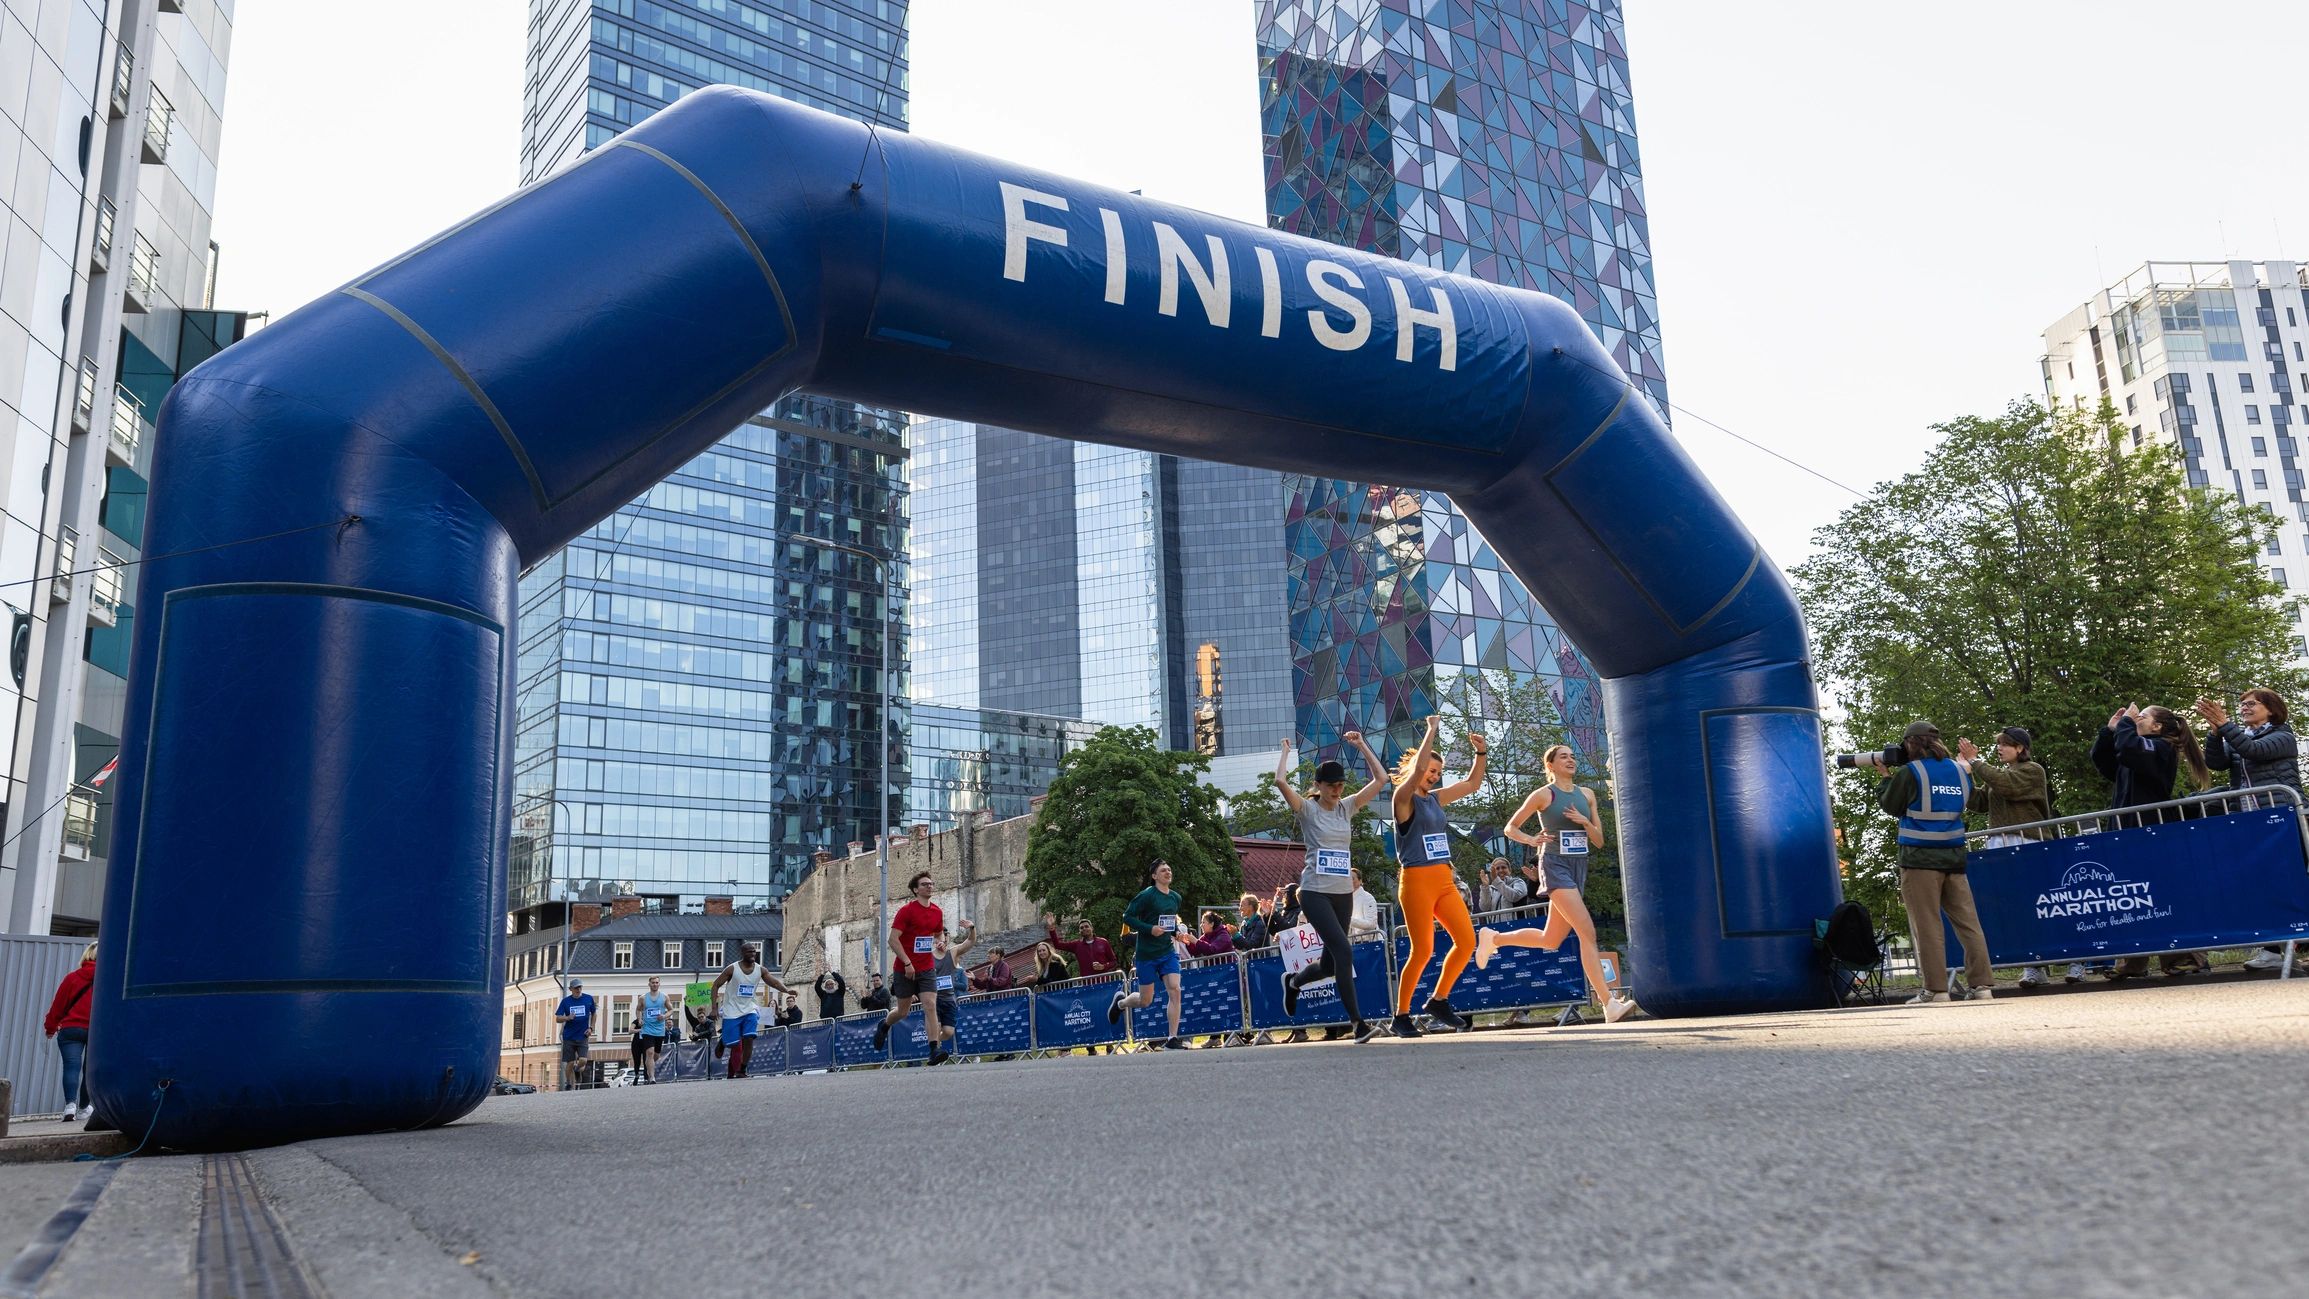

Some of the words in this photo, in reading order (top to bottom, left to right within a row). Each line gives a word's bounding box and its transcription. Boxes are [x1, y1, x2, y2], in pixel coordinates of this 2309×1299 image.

[999, 180, 1457, 372] FINISH
[1931, 785, 1962, 796] PRESS
[1329, 857, 1348, 869] 1656
[2036, 887, 2106, 905] ANNUAL
[2108, 881, 2151, 897] CITY
[2036, 895, 2154, 919] MARATHON
[2076, 921, 2095, 932] Run
[2096, 919, 2107, 929] for
[2109, 913, 2136, 926] health
[2136, 909, 2153, 921] and
[1282, 936, 1296, 952] WE
[1296, 988, 1335, 1000] ARATHON
